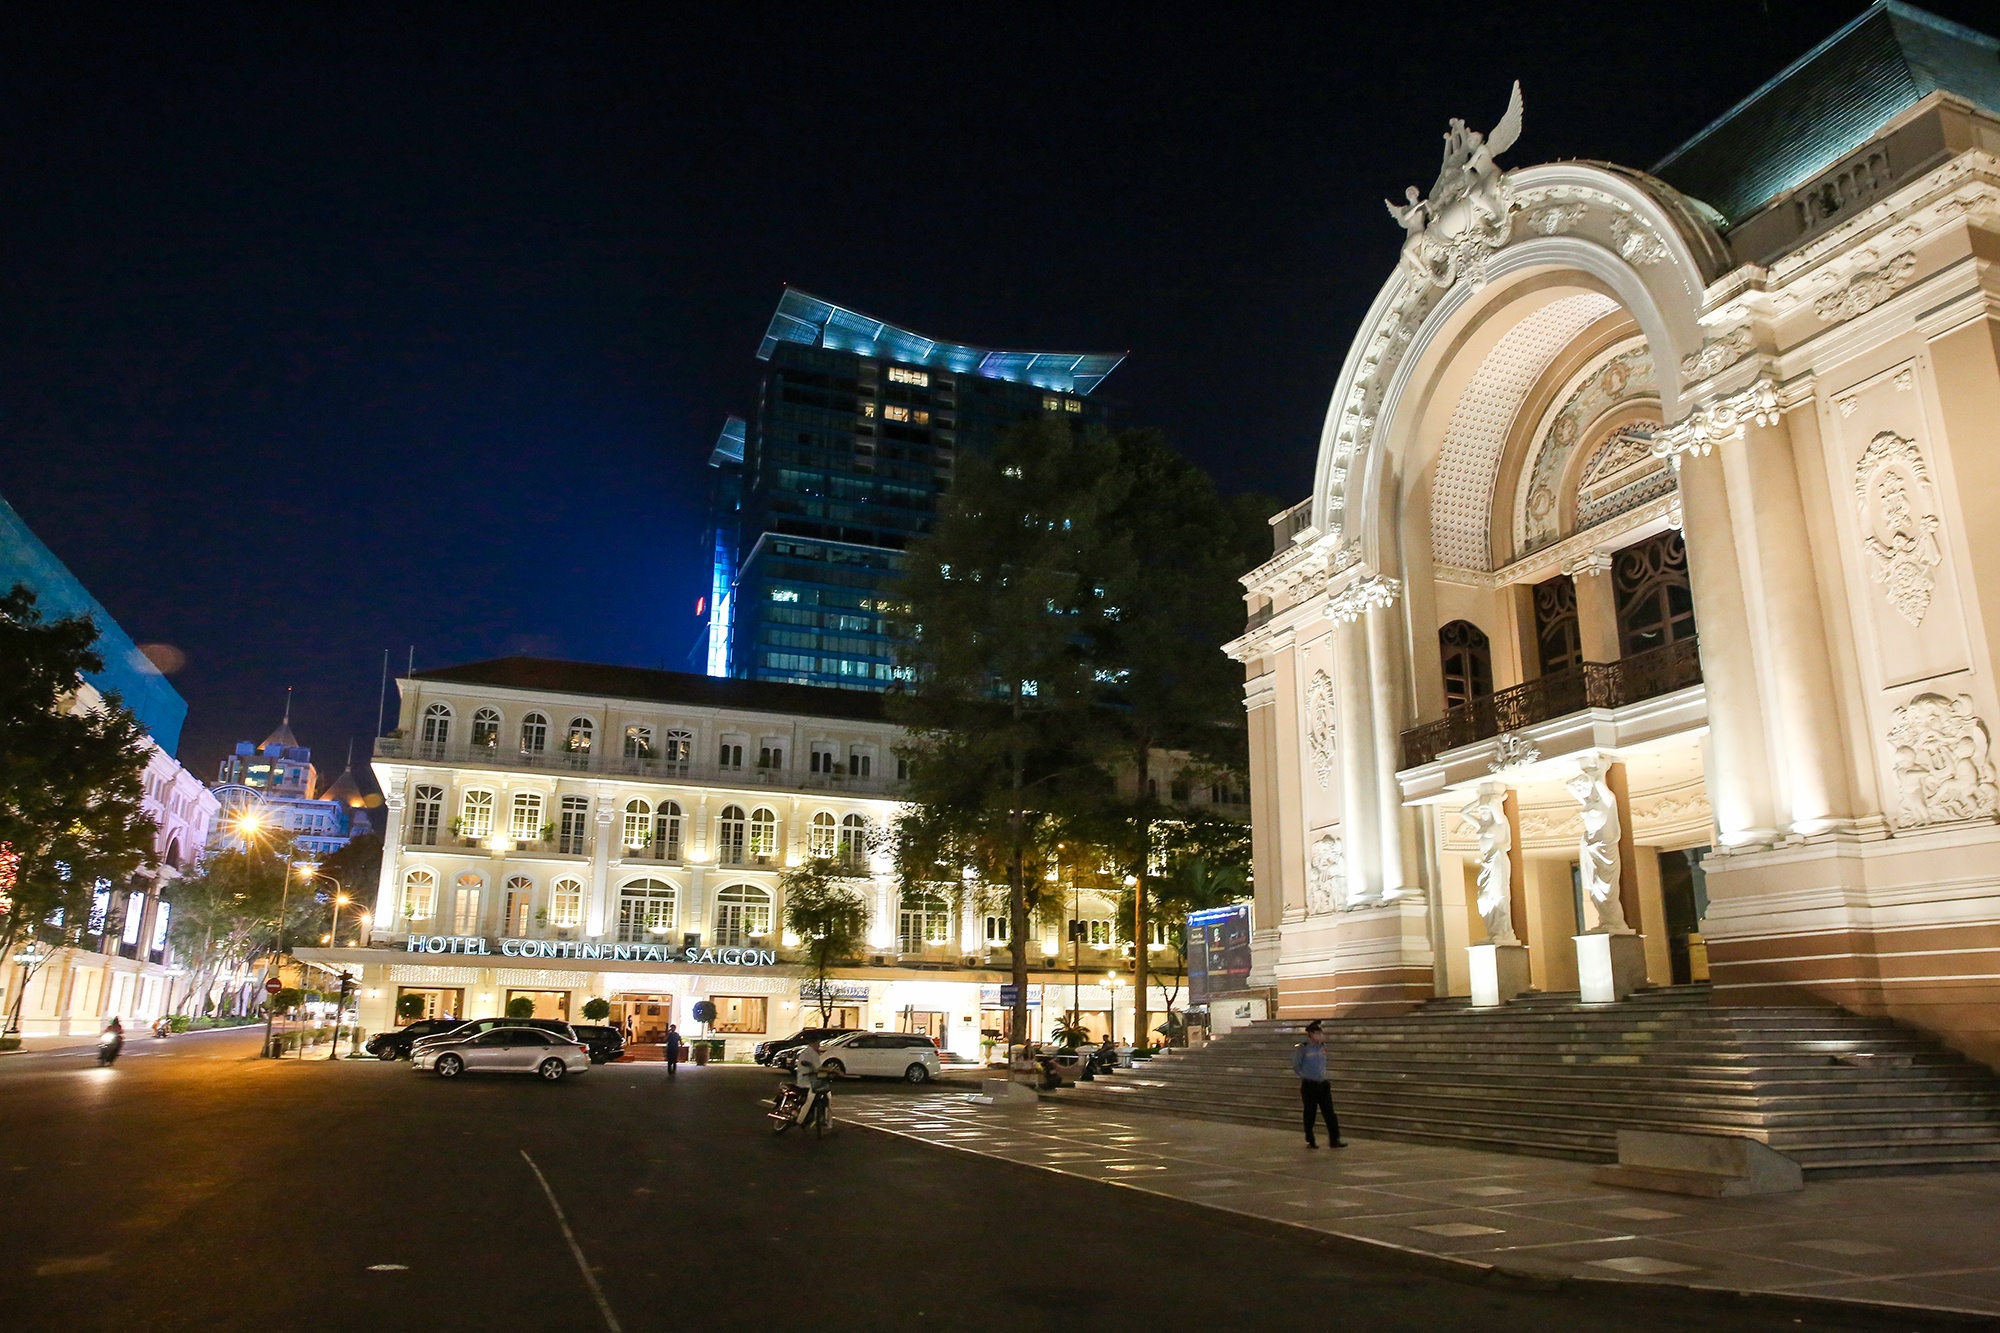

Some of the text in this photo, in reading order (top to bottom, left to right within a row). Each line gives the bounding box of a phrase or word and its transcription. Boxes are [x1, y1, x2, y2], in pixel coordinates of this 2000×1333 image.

[407, 934, 777, 966] HOTEL CONTINENTAL SAIGON
